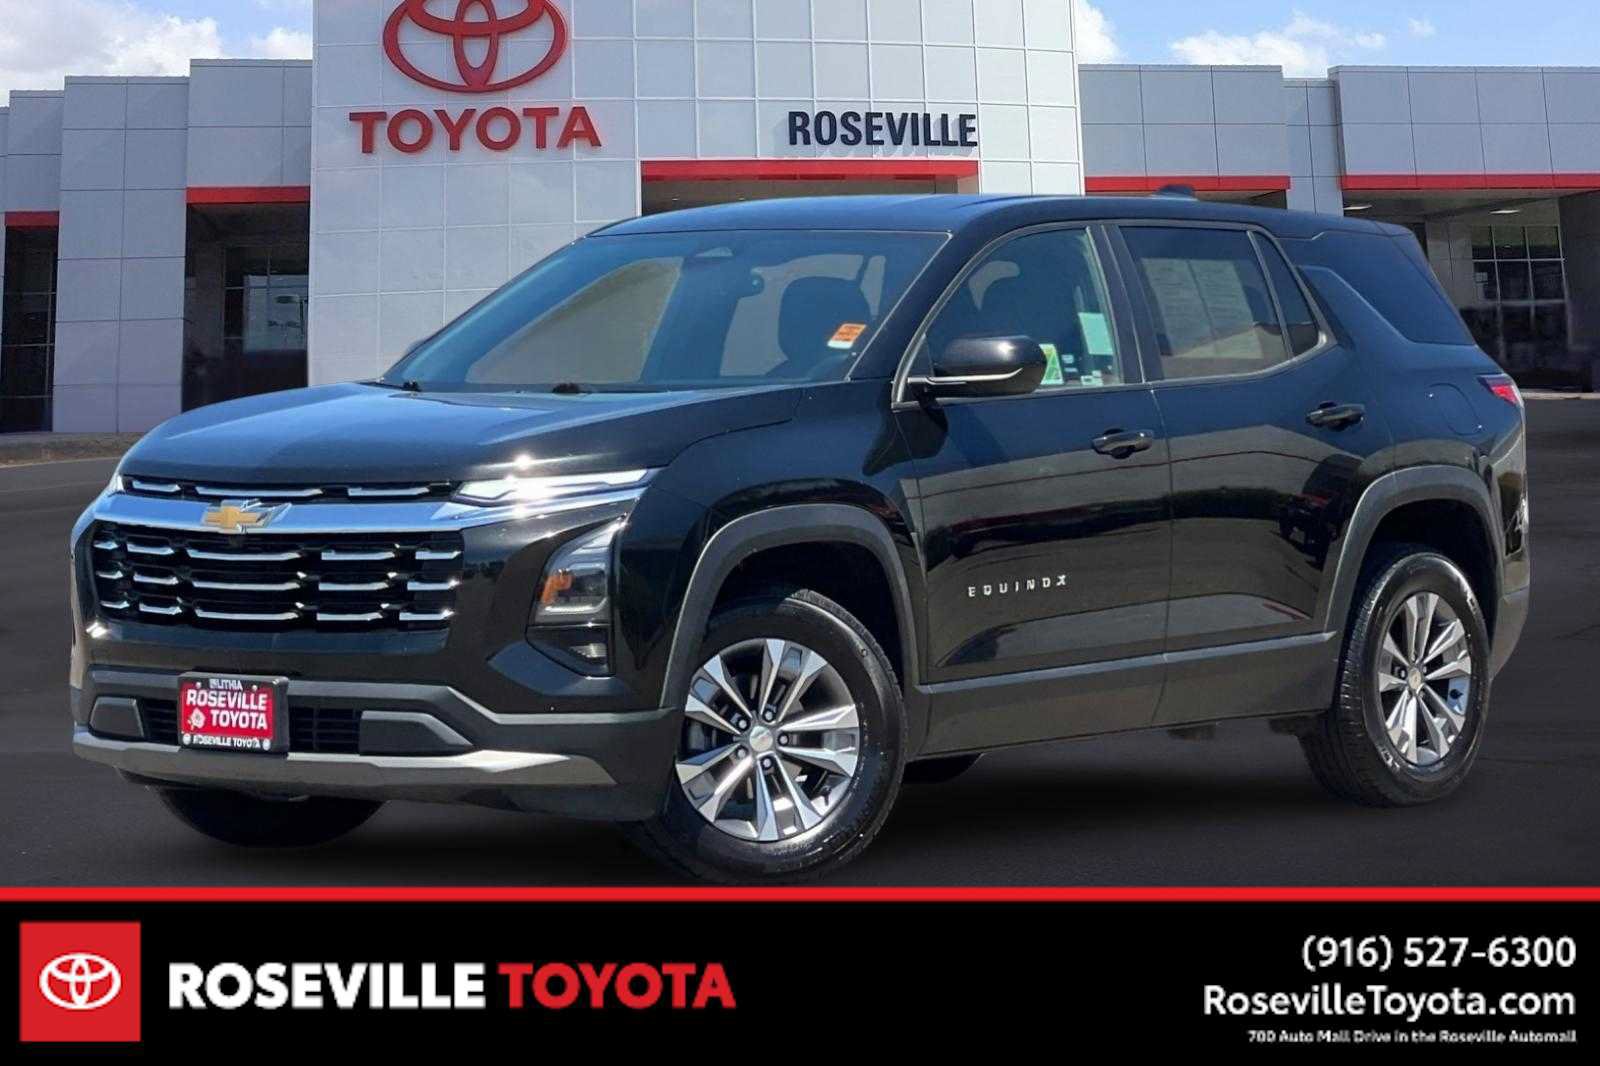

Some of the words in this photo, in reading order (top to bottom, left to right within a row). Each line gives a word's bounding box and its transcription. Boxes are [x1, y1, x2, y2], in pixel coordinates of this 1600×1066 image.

[349, 106, 602, 154] TOYOTA
[788, 110, 979, 147] ROSEVILLE
[967, 574, 1067, 598] EQUINOX
[217, 679, 243, 690] LITHIA
[186, 688, 268, 711] ROSEVILLE
[210, 709, 268, 730] TOYOTA
[193, 734, 231, 746] ROSEVILLE
[232, 737, 261, 748] TOYOTA
